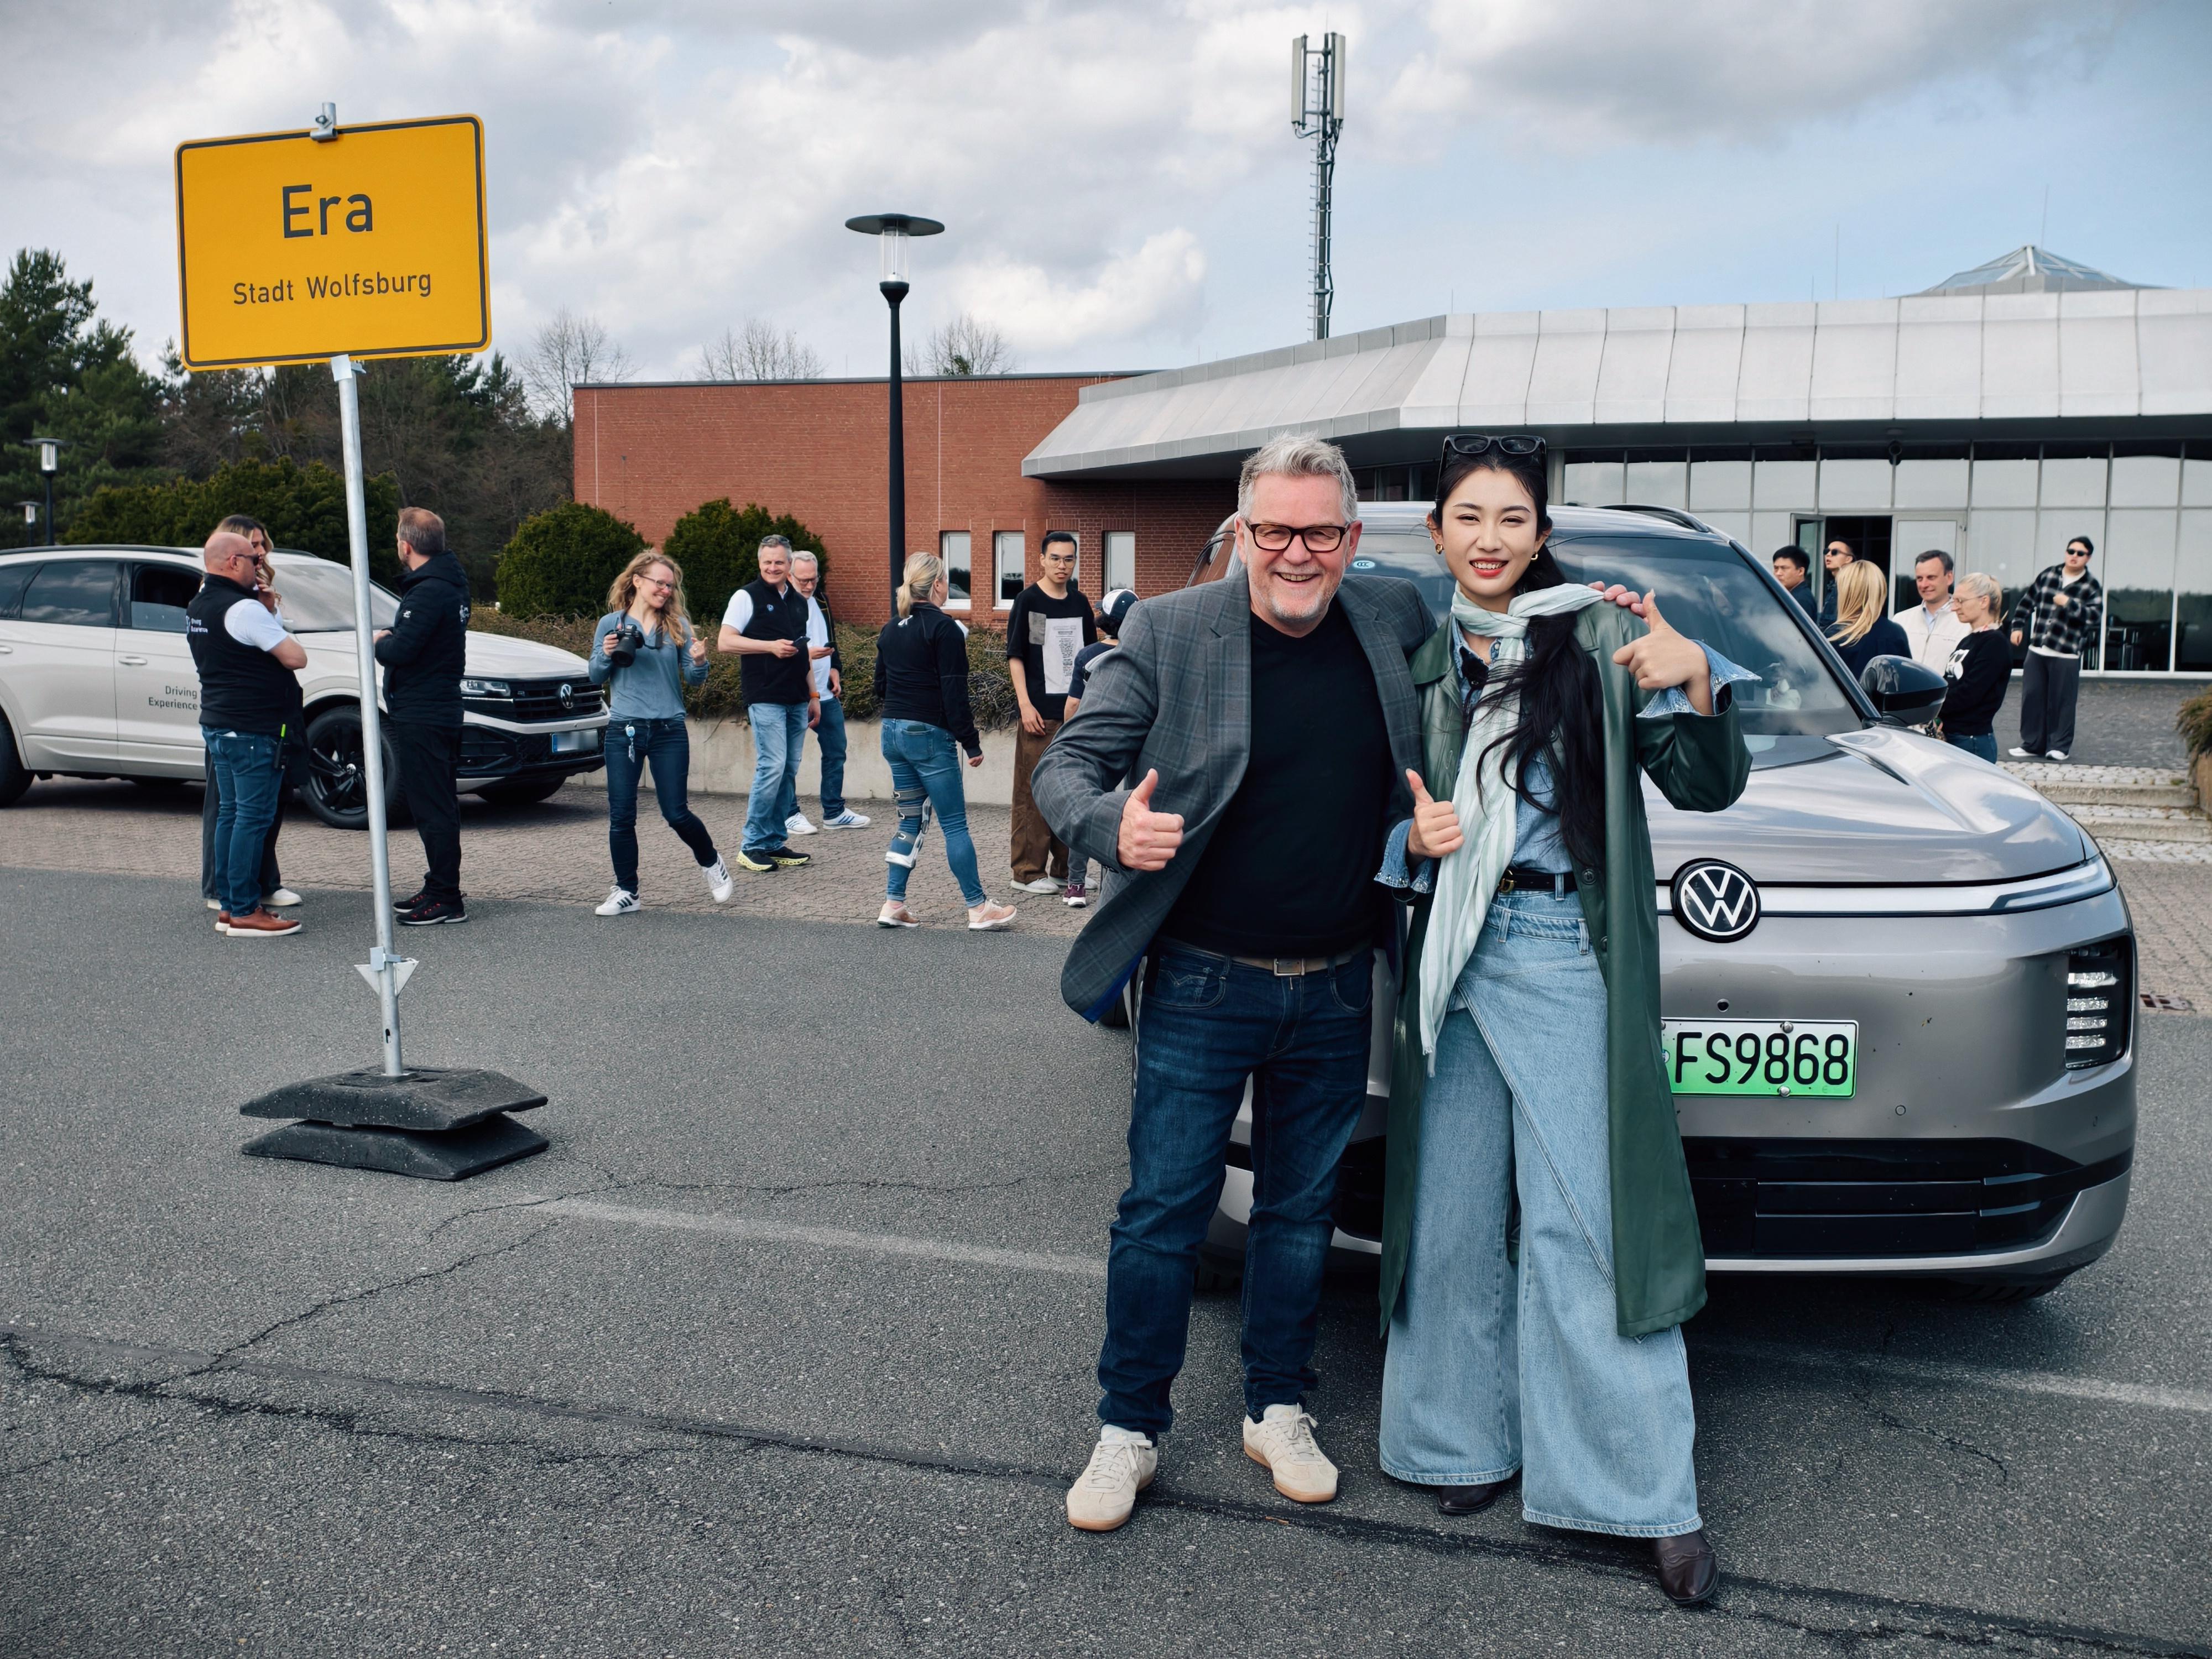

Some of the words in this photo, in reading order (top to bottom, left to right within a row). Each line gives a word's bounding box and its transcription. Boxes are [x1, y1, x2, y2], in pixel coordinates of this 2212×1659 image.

[281, 184, 374, 238] Era
[233, 279, 294, 305] Stadt
[306, 272, 431, 299] Wolfsburg
[148, 696, 198, 711] Experience
[165, 685, 197, 700] Driving
[1681, 867, 1756, 936] VW
[1674, 1031, 1849, 1086] FS9868
